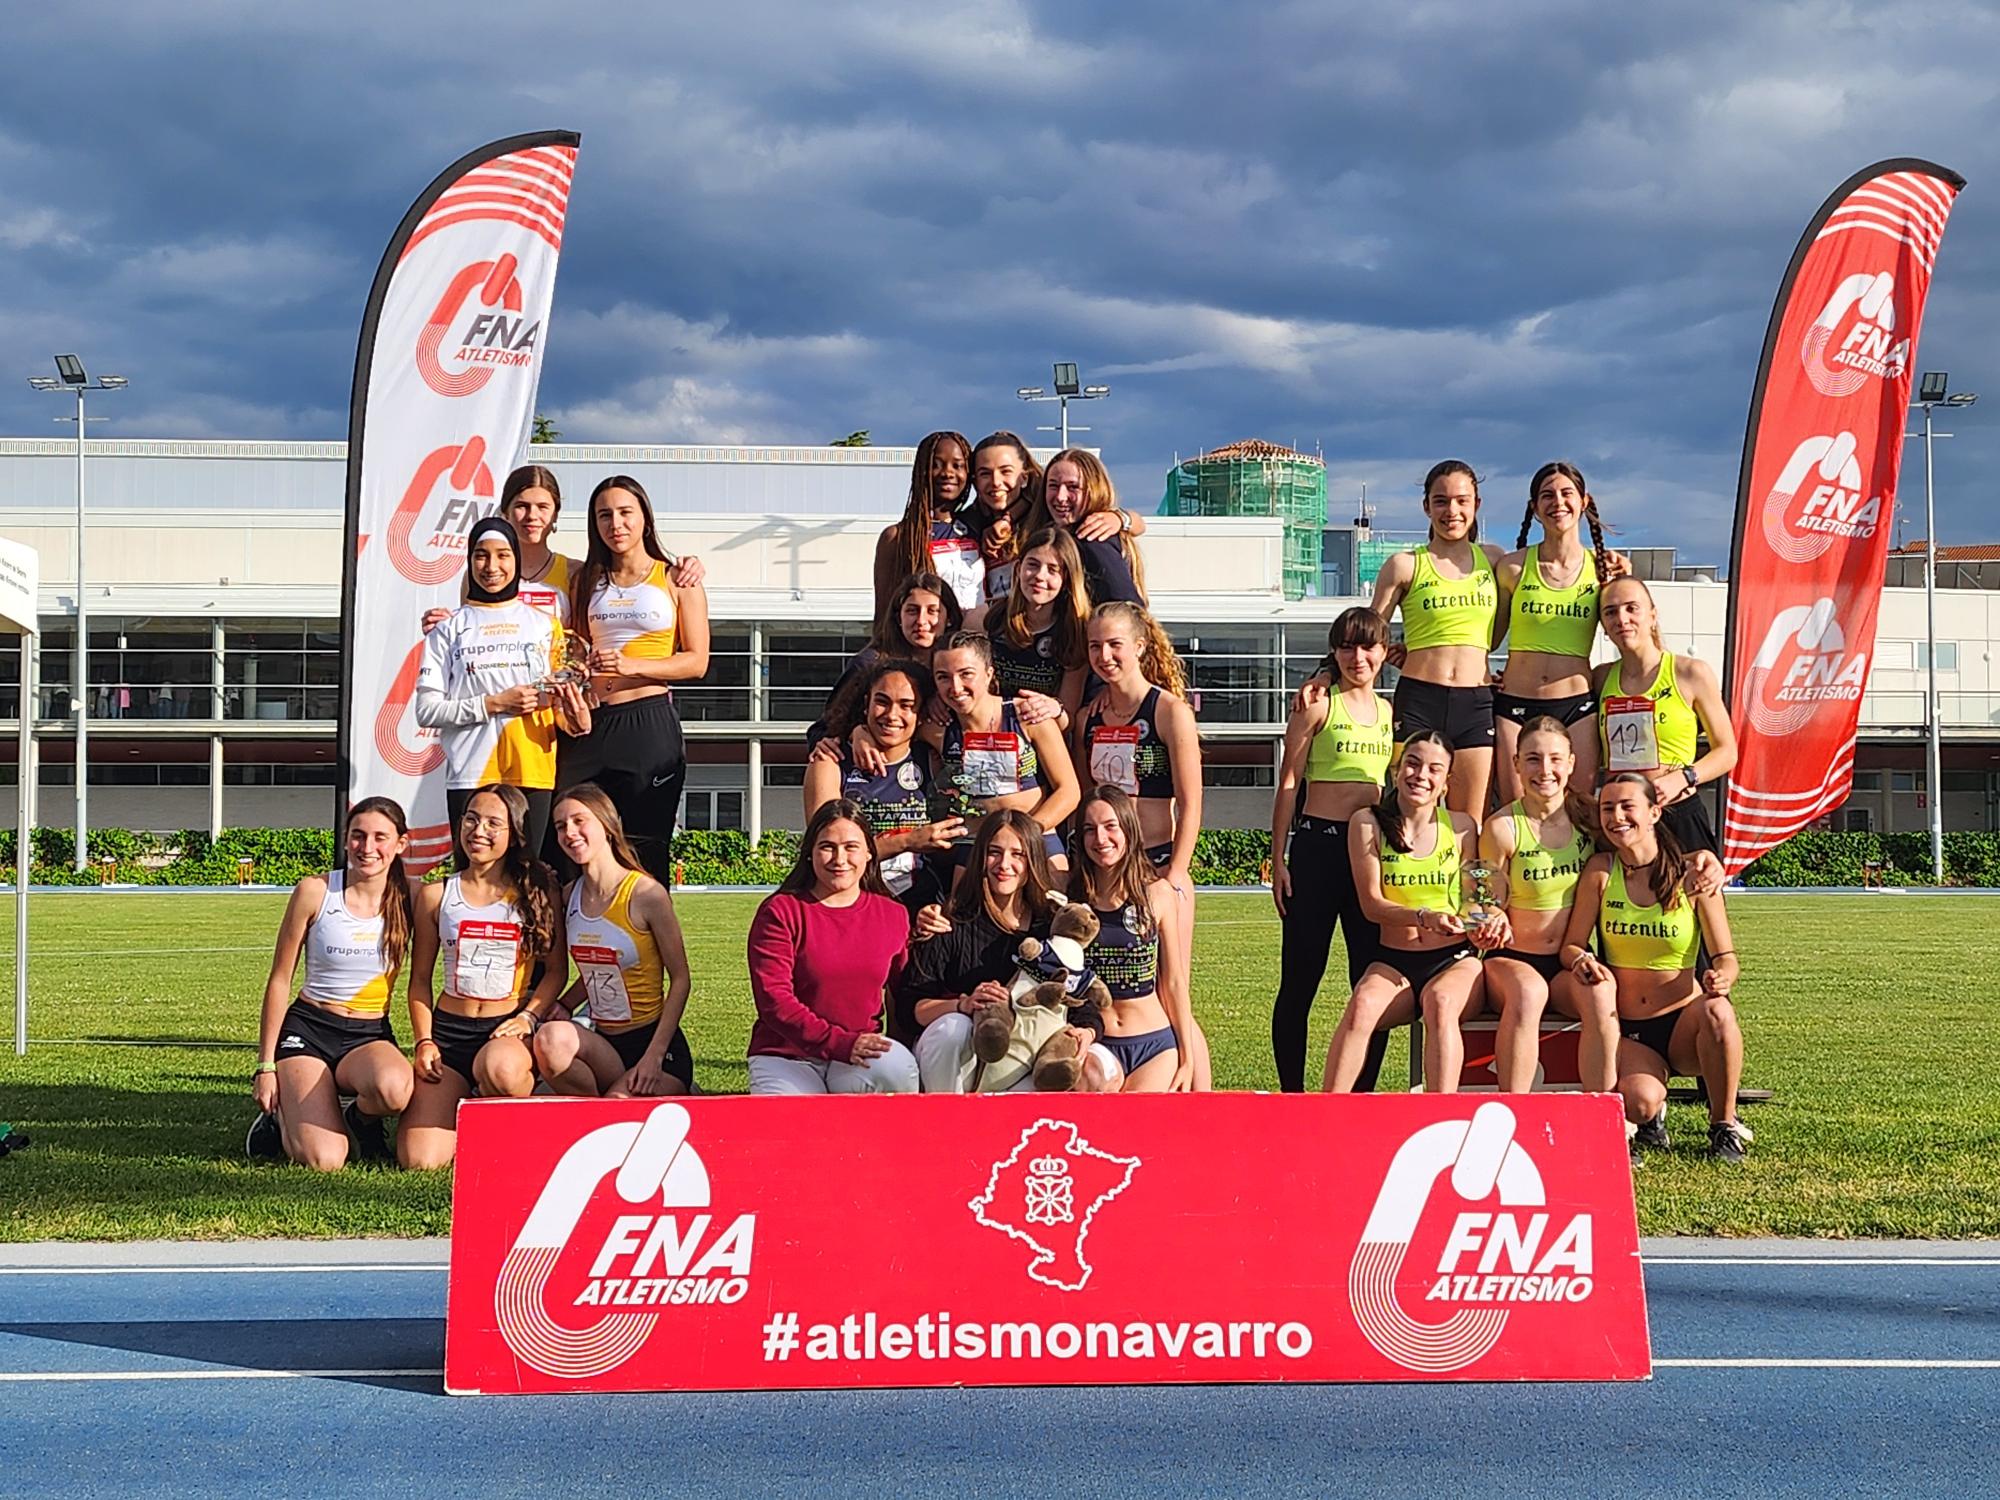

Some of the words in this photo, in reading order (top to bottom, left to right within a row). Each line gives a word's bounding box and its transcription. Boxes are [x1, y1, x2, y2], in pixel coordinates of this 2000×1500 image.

[462, 313, 541, 353] FNA
[1840, 321, 1911, 366] FNA
[434, 498, 494, 533] FN
[1802, 484, 1881, 526] FNA
[1794, 514, 1877, 539] ATLETISMO
[1423, 591, 1492, 610] etxenike
[1521, 600, 1590, 618] etxenike
[1782, 652, 1867, 687] FNA
[1774, 685, 1861, 701] ATLETISMO
[1610, 722, 1646, 755] 12
[1383, 869, 1447, 887] etxenik
[1523, 857, 1586, 881] etxenik
[1605, 919, 1679, 938] etxenike
[470, 944, 493, 980] 4
[586, 969, 618, 1006] 13
[588, 1214, 756, 1277] FNA
[1436, 1212, 1593, 1275] FNA
[572, 1277, 749, 1306] ATLETISMO
[1424, 1274, 1594, 1303] ATLETISMO
[762, 1311, 1313, 1362] #atletismonavarro
